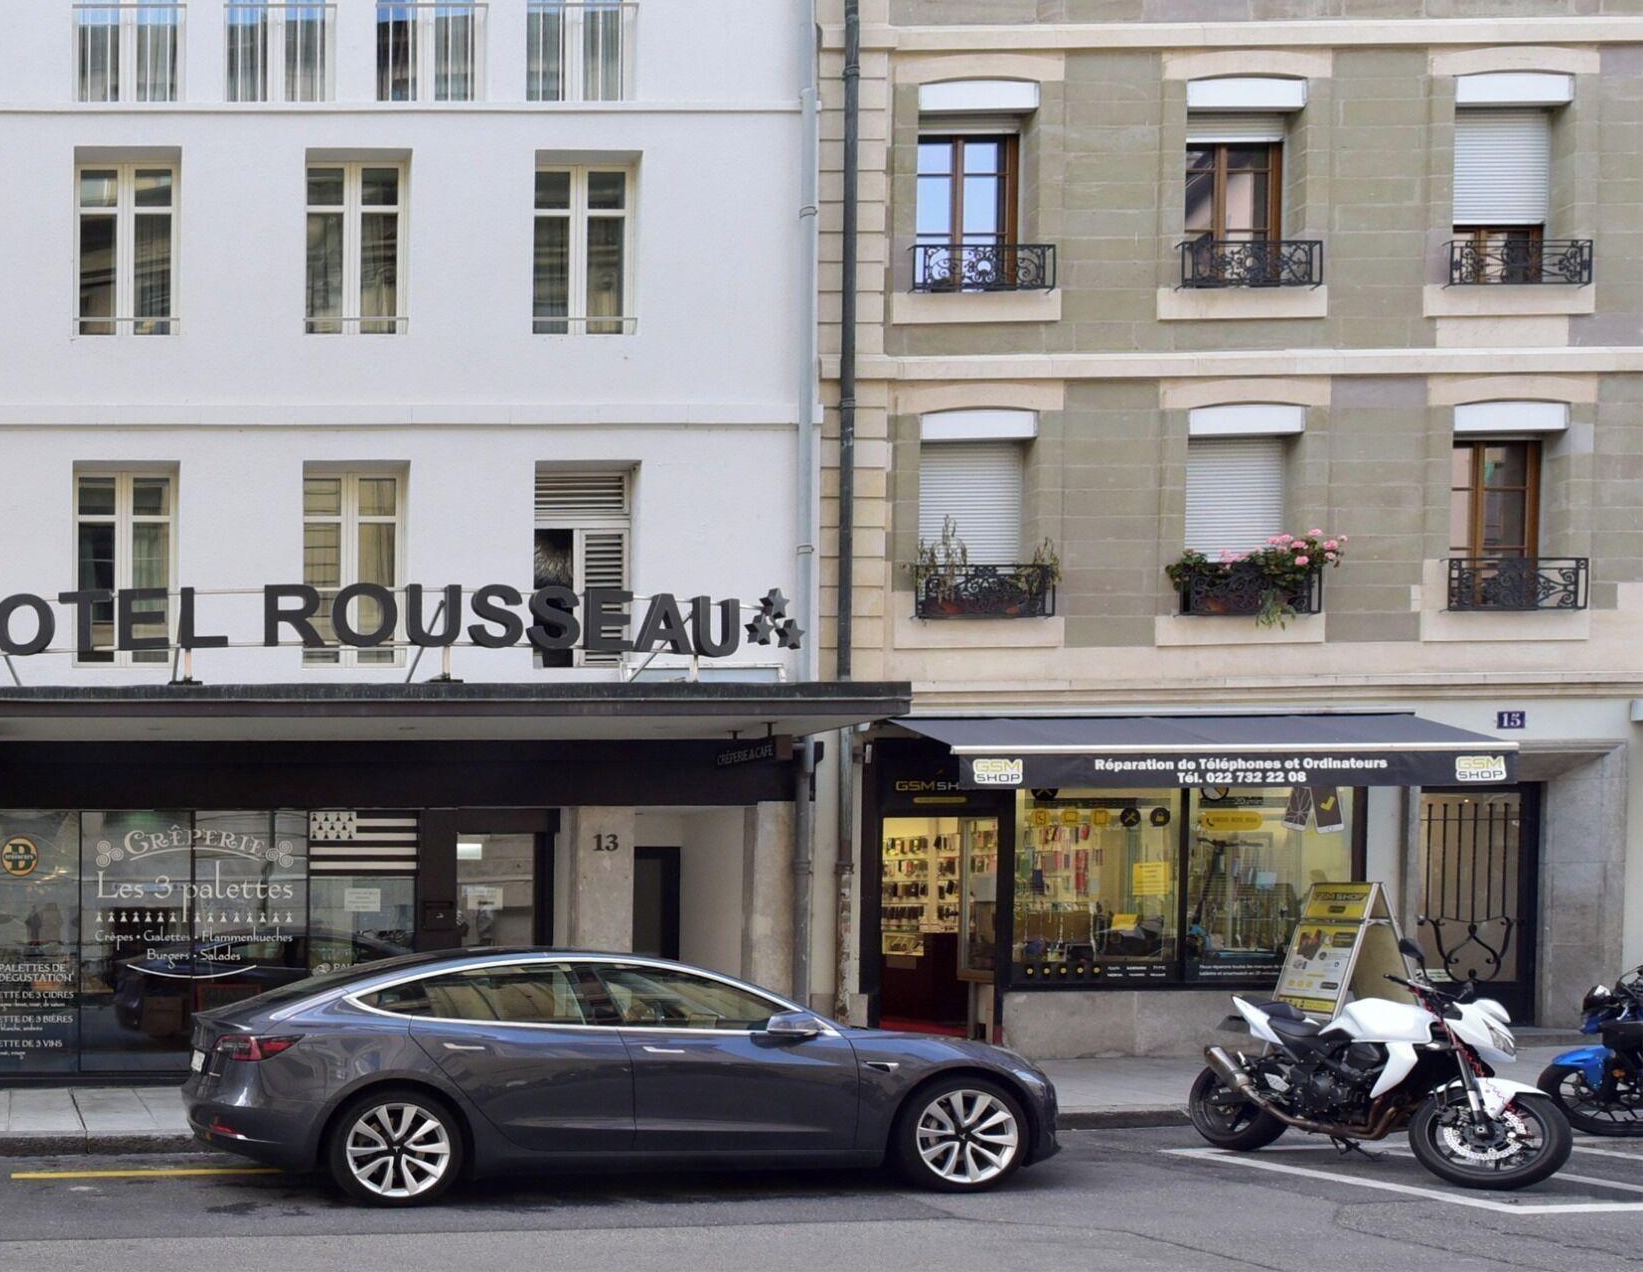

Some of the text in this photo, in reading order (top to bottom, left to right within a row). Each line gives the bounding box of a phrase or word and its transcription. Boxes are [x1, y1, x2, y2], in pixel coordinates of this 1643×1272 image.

[264, 582, 741, 658] ROUSSEAU
[1502, 713, 1521, 727] 15
[975, 760, 1020, 772] GSM
[1094, 757, 1388, 772] Réparation de Téléphones et Ordinateurs
[1457, 757, 1503, 769] GSM
[976, 773, 1021, 782] SHOP
[1177, 771, 1307, 783] Tél. 022 732 22 08
[1457, 770, 1504, 779] SHOP
[895, 780, 935, 791] GSM
[123, 824, 266, 857] CRÊPERIE
[592, 833, 619, 852] 13
[96, 860, 294, 923] Les 3 palettes
[143, 926, 191, 942] Galettes
[201, 926, 293, 942] Flammenkueches
[146, 945, 241, 969] Burgers Salades
[52, 963, 67, 972] DE
[22, 991, 35, 999] DE
[42, 991, 74, 999] CIDRES
[22, 1015, 35, 1023] DE
[22, 1039, 35, 1047] DE
[42, 1039, 63, 1047] VINS
